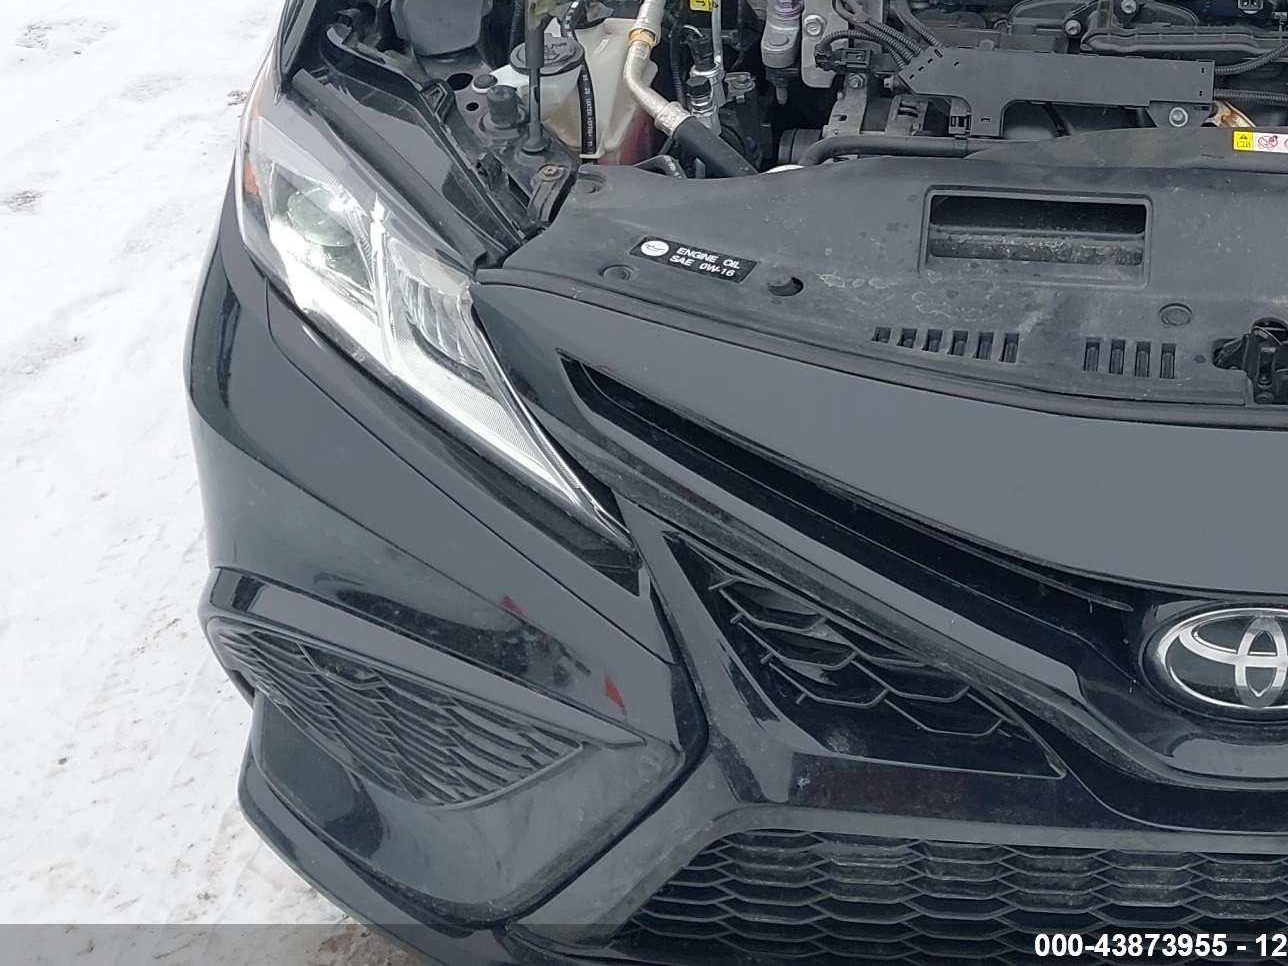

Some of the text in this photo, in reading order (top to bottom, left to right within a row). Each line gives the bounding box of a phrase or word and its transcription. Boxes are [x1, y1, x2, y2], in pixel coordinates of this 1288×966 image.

[669, 255, 736, 277] SAE 0W-16
[676, 247, 741, 270] ENGINE OIL
